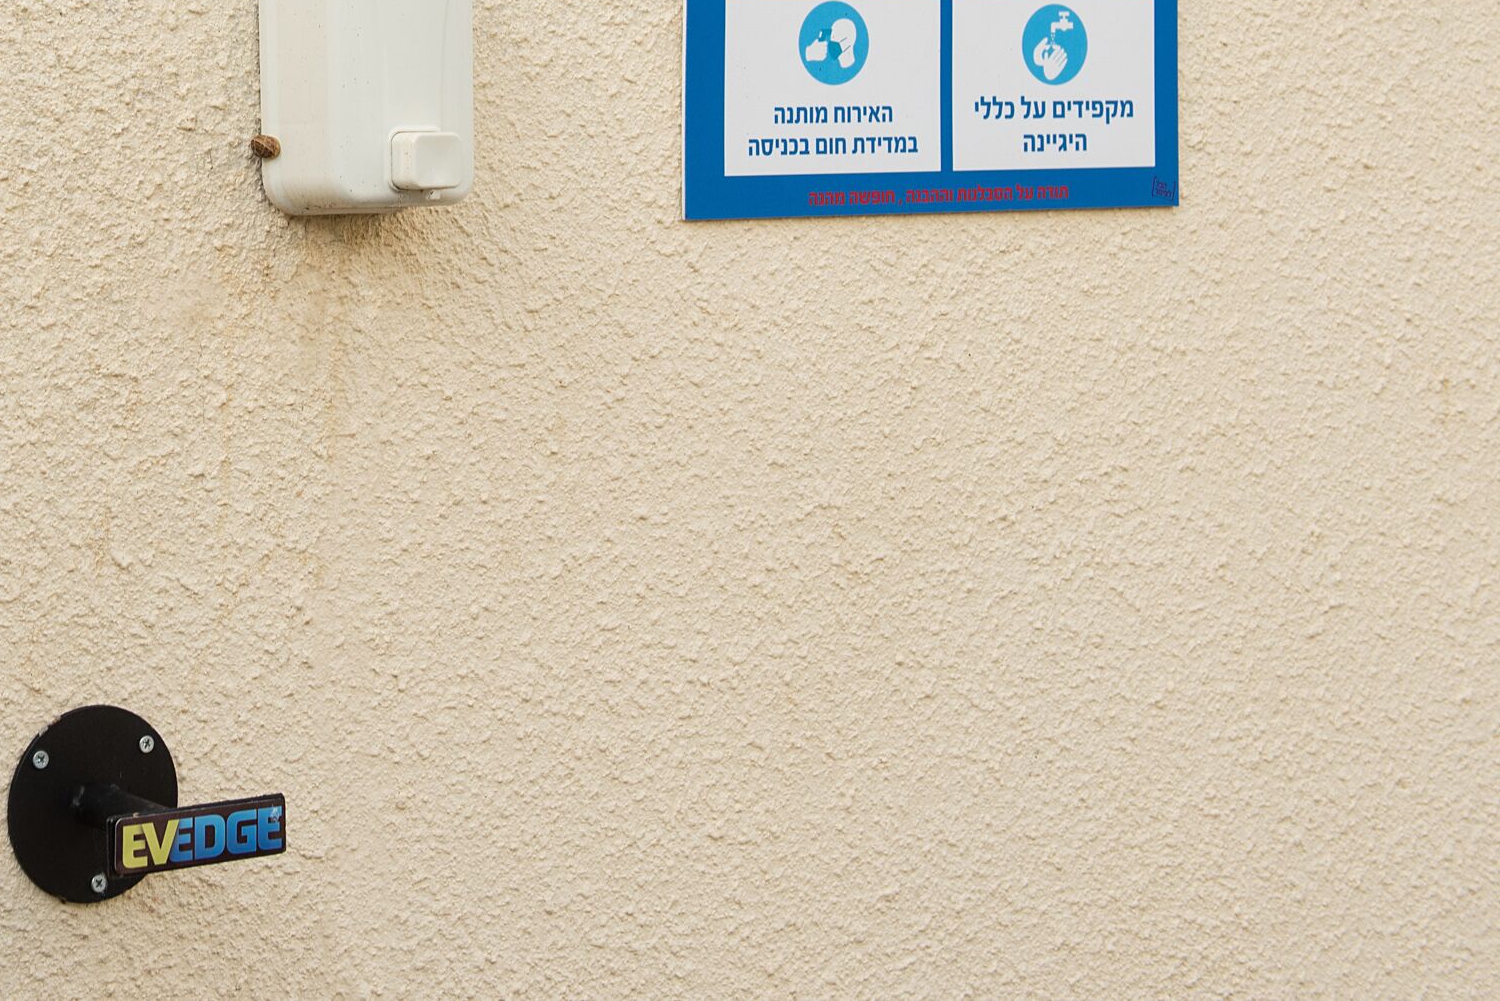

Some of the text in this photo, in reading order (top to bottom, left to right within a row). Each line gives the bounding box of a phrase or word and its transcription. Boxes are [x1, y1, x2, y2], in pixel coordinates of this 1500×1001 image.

[775, 106, 892, 124] האירוח מותנה
[975, 96, 1133, 124] מקפידים על כללי
[749, 137, 918, 156] במדידת חום בכניסה
[1024, 134, 1087, 152] היגיינה
[849, 190, 895, 205] חופשה
[956, 183, 1013, 202] הסבלנות
[1015, 183, 1034, 200] על
[1037, 185, 1069, 199] תודה
[122, 805, 282, 869] EVEDGE
